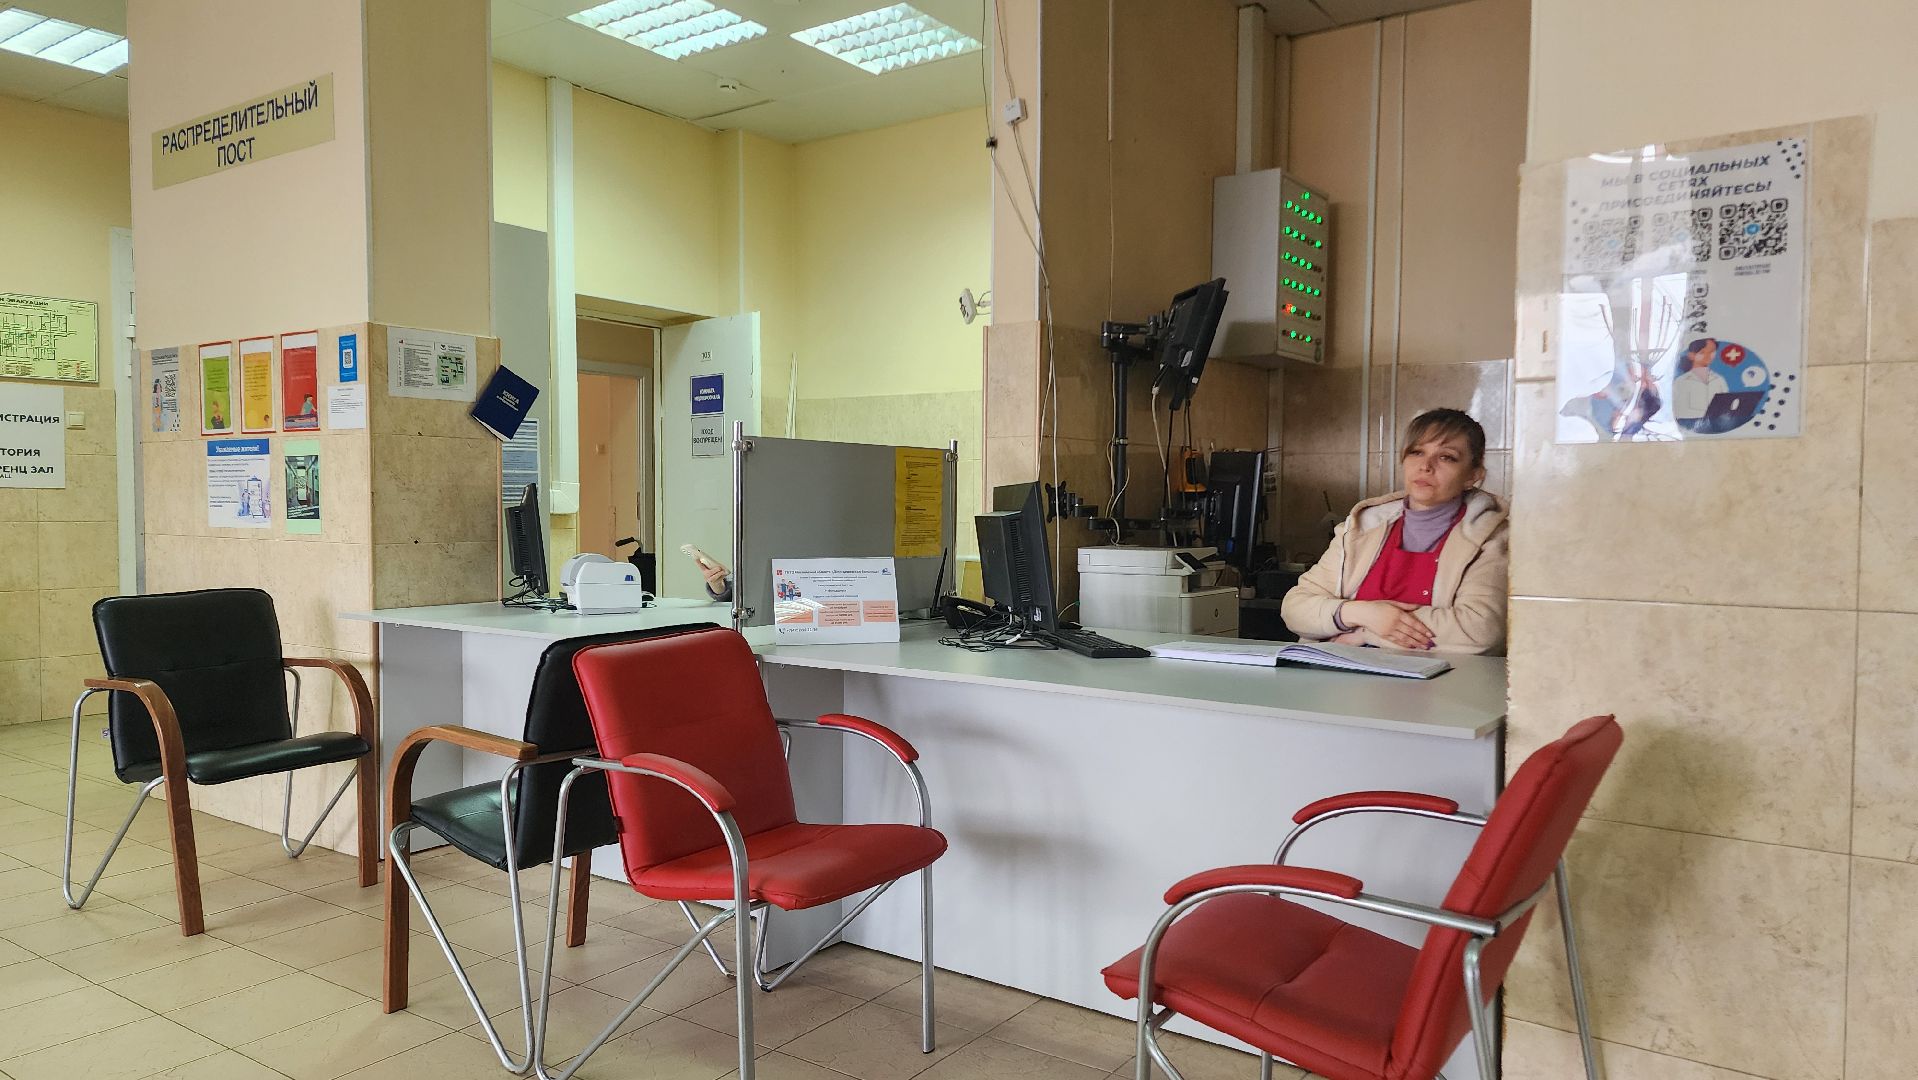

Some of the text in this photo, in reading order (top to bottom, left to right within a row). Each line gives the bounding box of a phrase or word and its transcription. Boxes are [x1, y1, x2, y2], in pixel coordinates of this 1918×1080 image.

[162, 80, 318, 155] РАСПРЕДЕЛИТЕЛЬНЫЙ
[217, 137, 256, 167] ПОСТ
[1601, 155, 1770, 188] МЫ В СОЦИАЛЬНЫХ
[1658, 176, 1709, 192] СЕТЯХ
[1600, 181, 1772, 210] ПРИСОЕДИНЯЙТЕСЬ!
[31, 466, 54, 474] ЗАЛ
